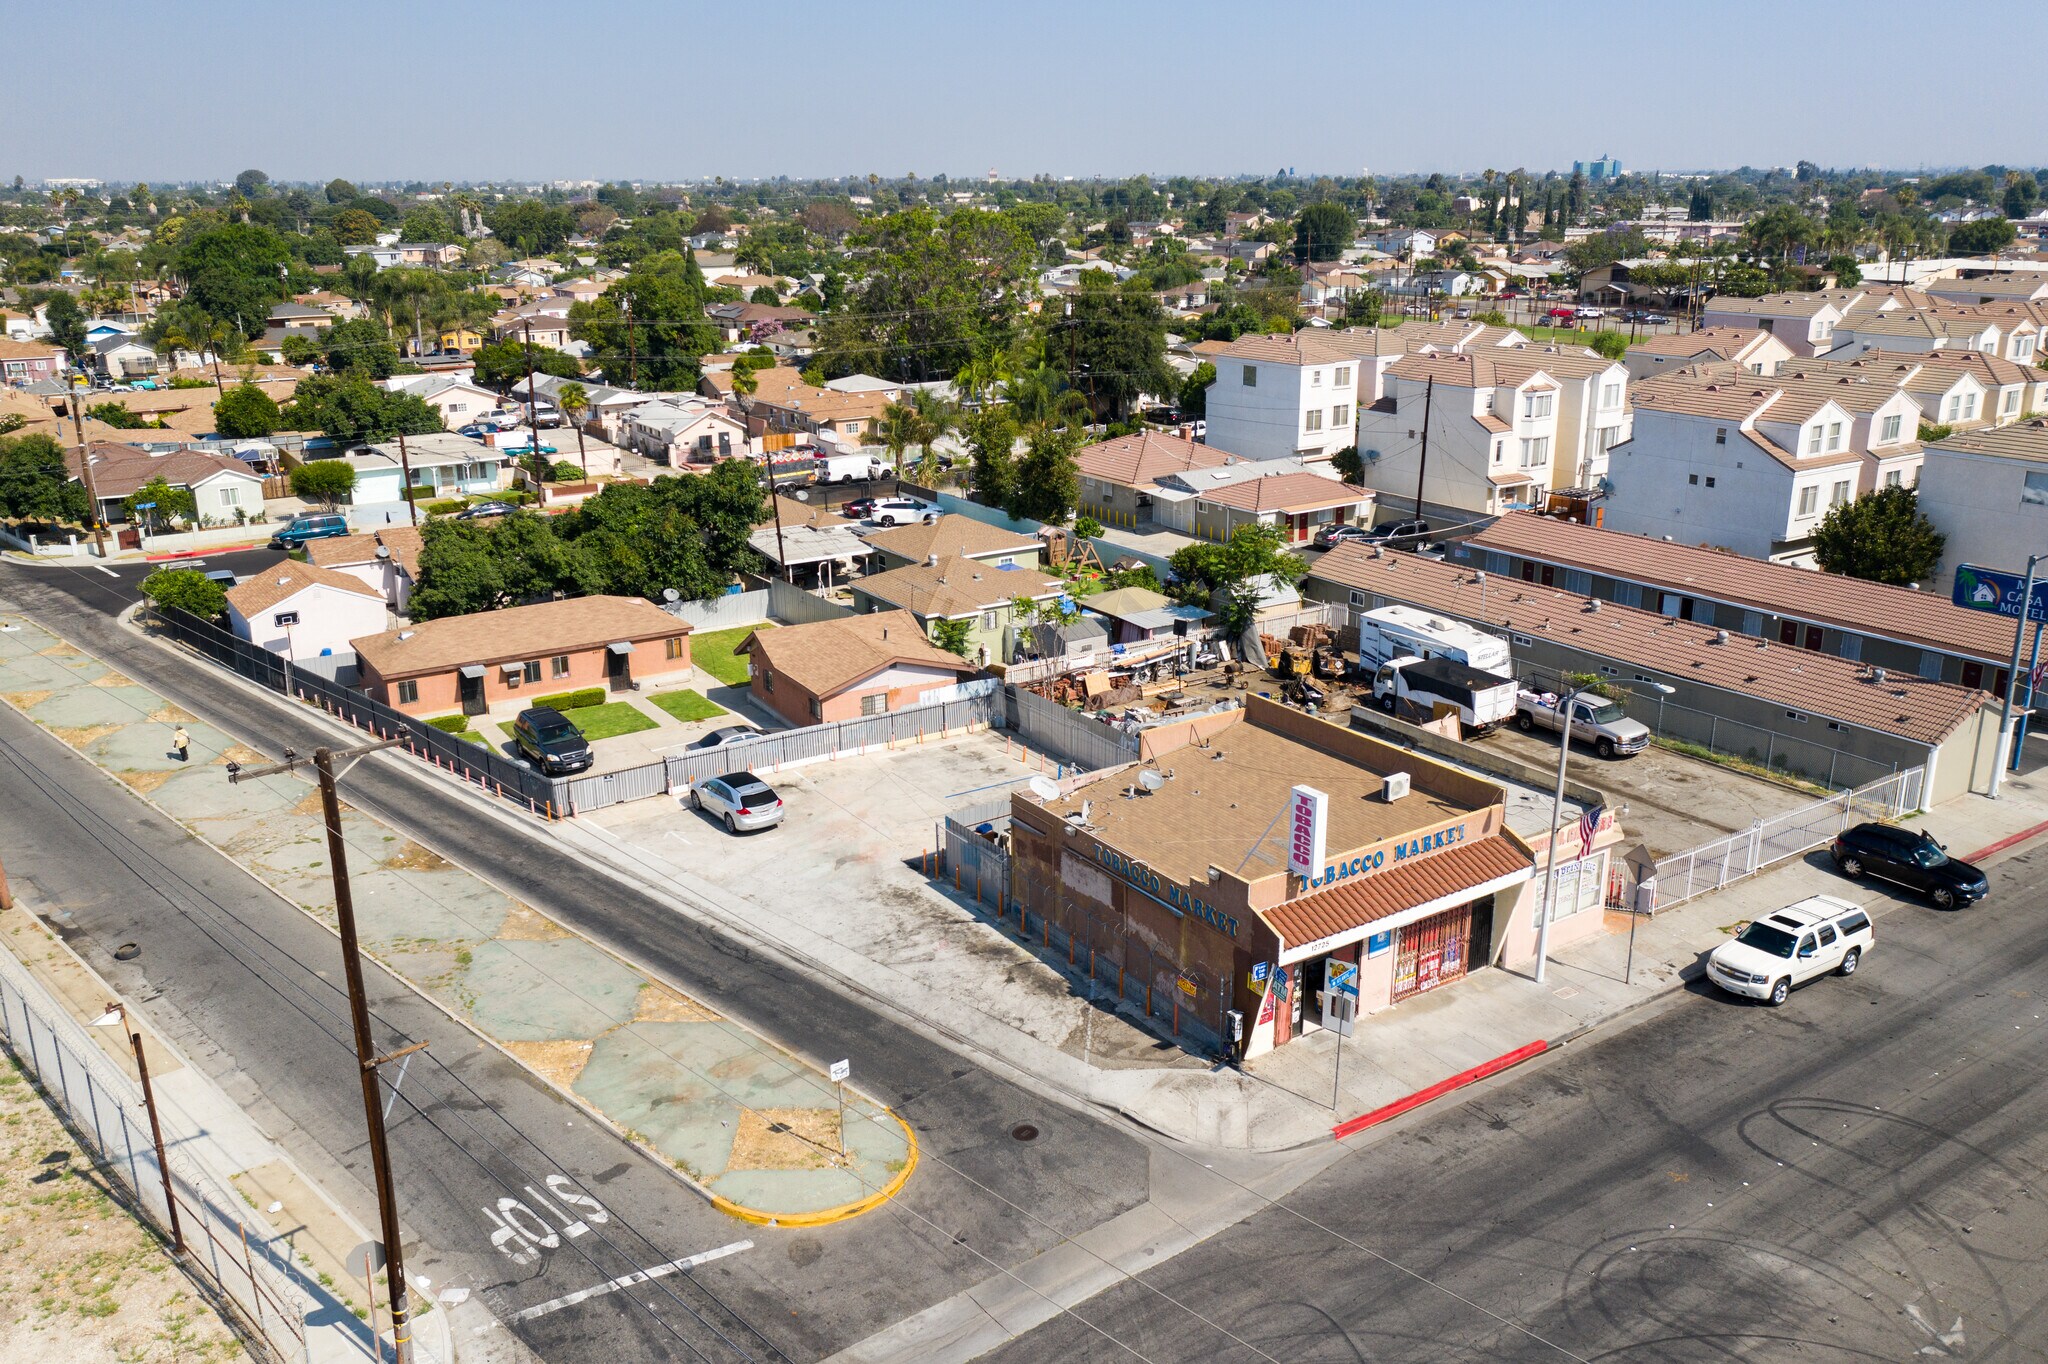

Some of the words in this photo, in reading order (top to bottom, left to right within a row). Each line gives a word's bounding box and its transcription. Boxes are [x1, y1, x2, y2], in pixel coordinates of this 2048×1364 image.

[1999, 602, 2047, 621] MOEL
[1293, 793, 1313, 866] TOBACCO
[1394, 824, 1466, 862] MARKET
[1093, 843, 1161, 893] TOBACCO
[1169, 884, 1239, 938] MARKET
[1311, 940, 1330, 951] 12725
[1272, 980, 1288, 996] ATM
[481, 1174, 609, 1265] STOP
